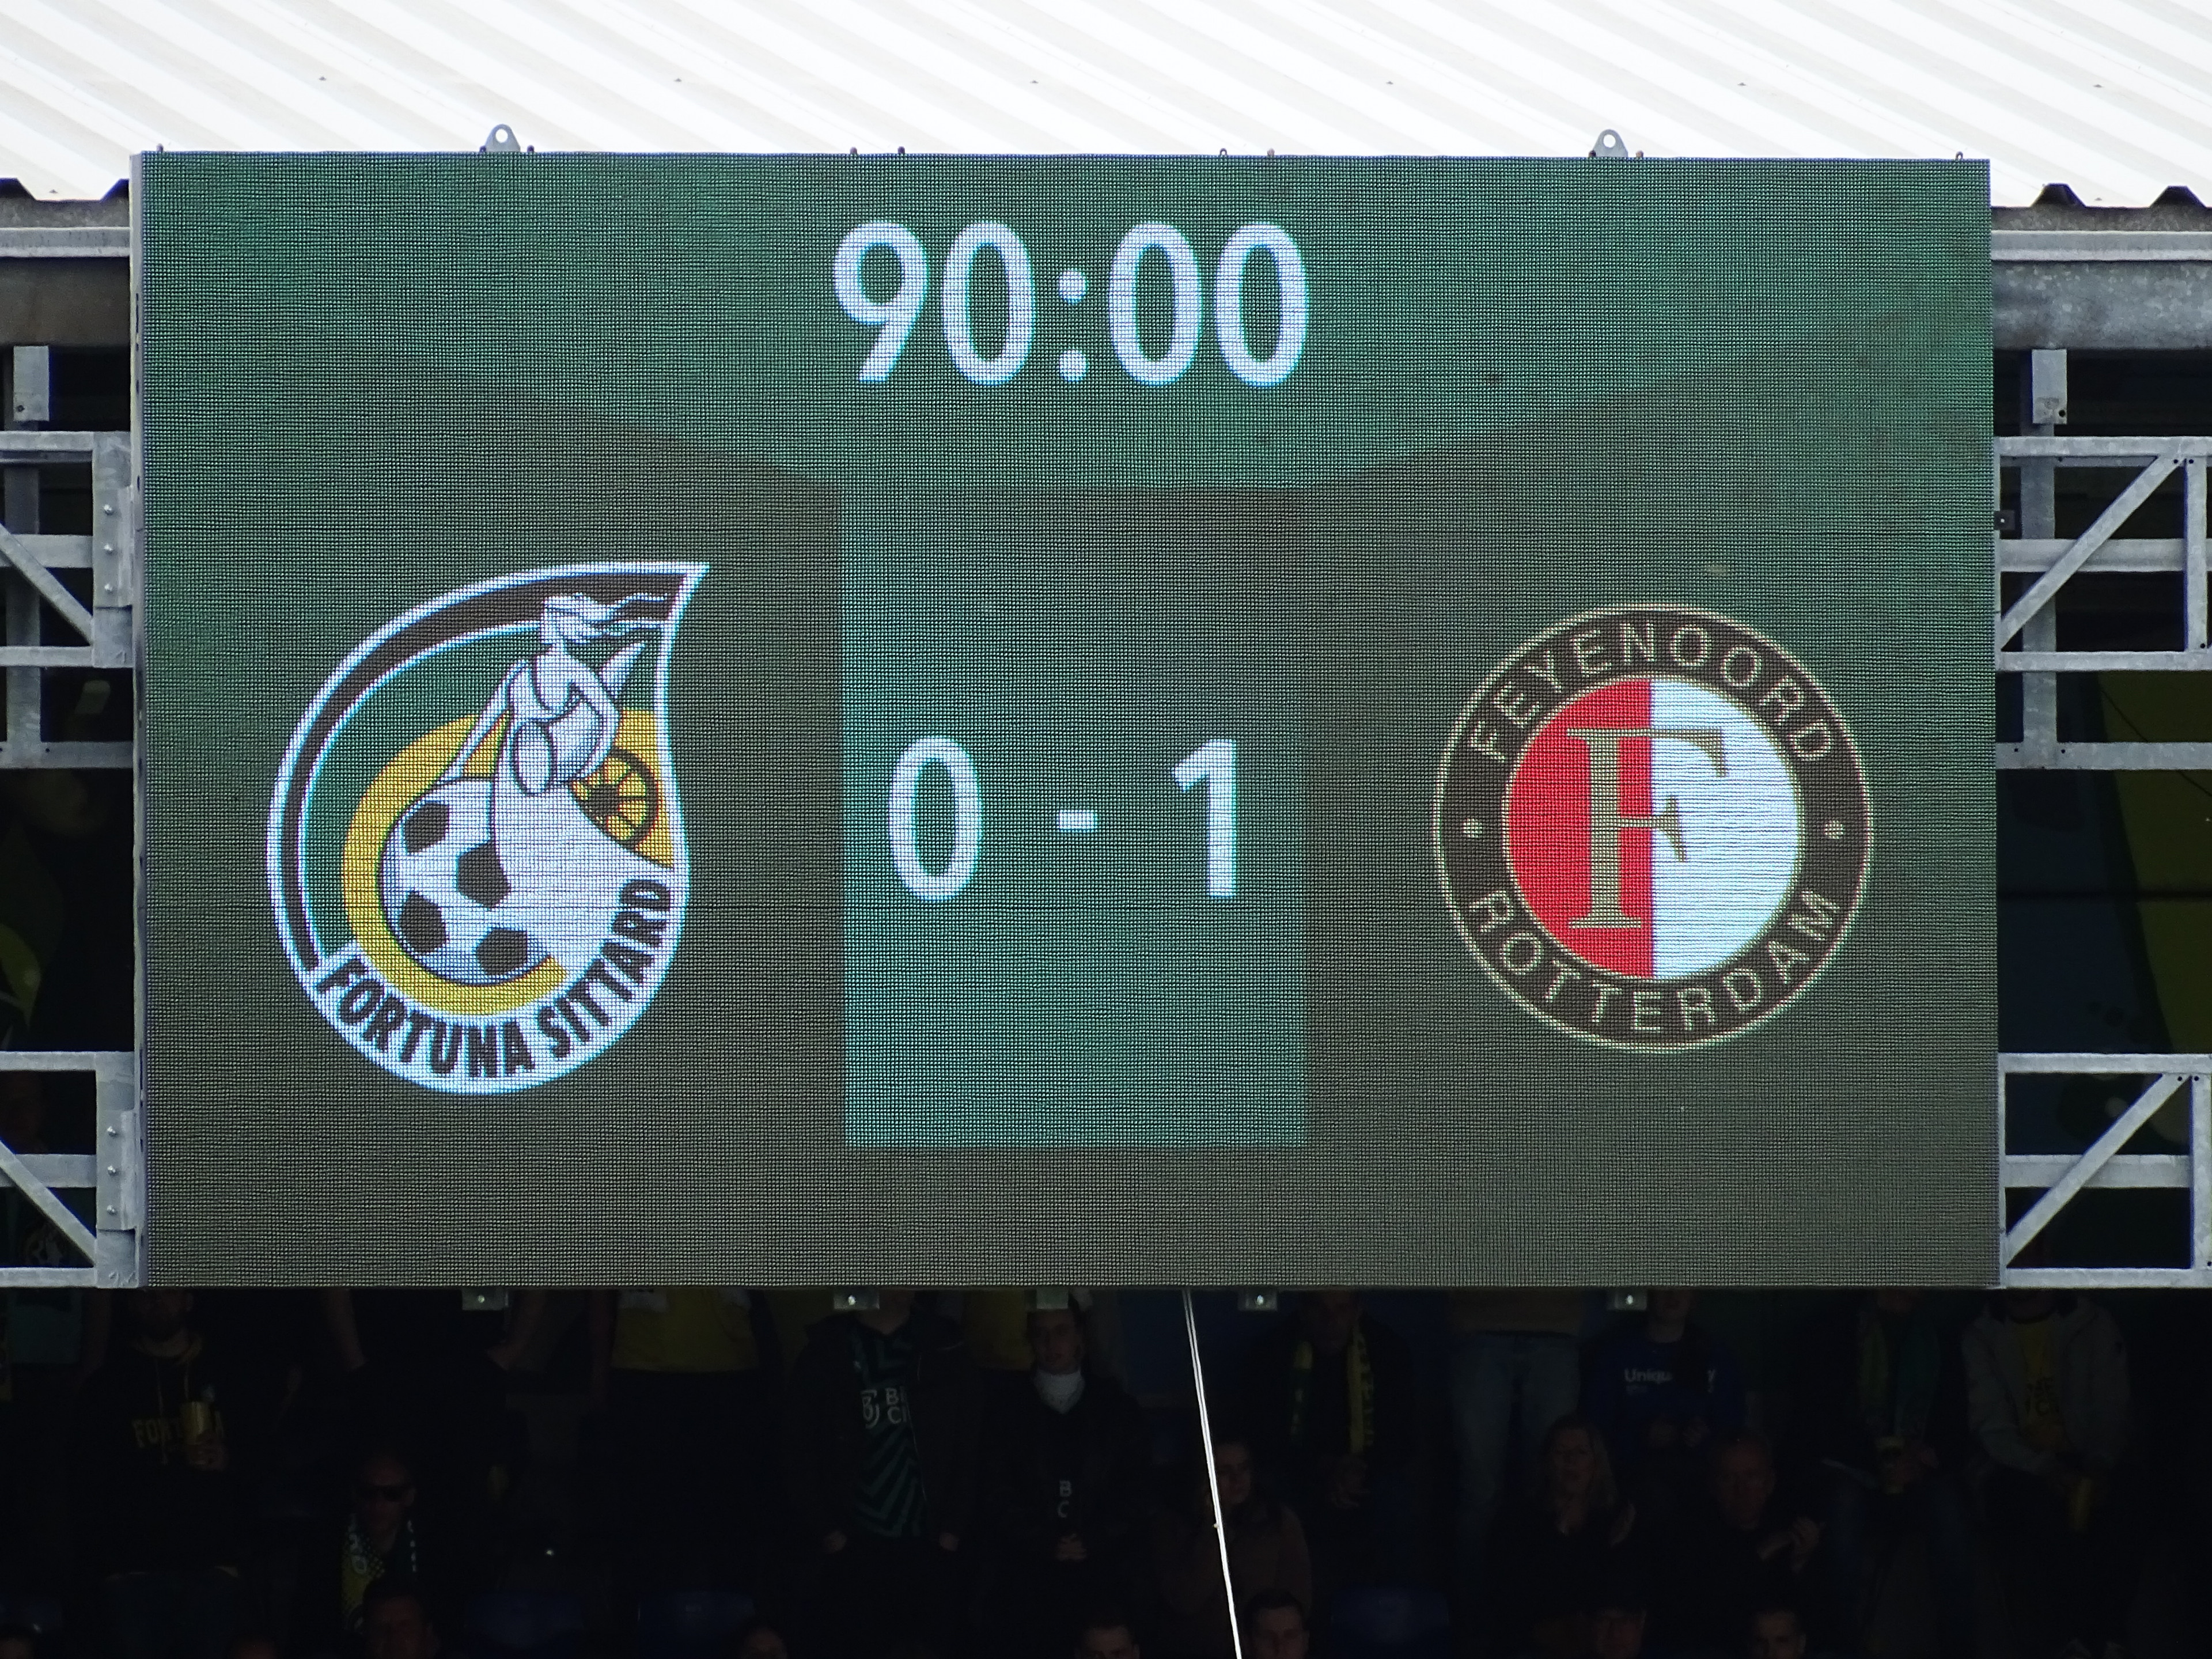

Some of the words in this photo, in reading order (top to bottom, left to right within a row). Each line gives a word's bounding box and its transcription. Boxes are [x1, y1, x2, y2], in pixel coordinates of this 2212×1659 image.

[833, 220, 1310, 386] 90:00
[1469, 622, 1832, 762] FEYENOORD
[888, 736, 983, 902] 0
[1173, 739, 1237, 896] 1
[1566, 728, 1727, 930] F
[315, 959, 535, 1077] FORTUNA
[536, 878, 672, 1061] SITTARD
[1469, 890, 1840, 1032] ROTTERDAM
